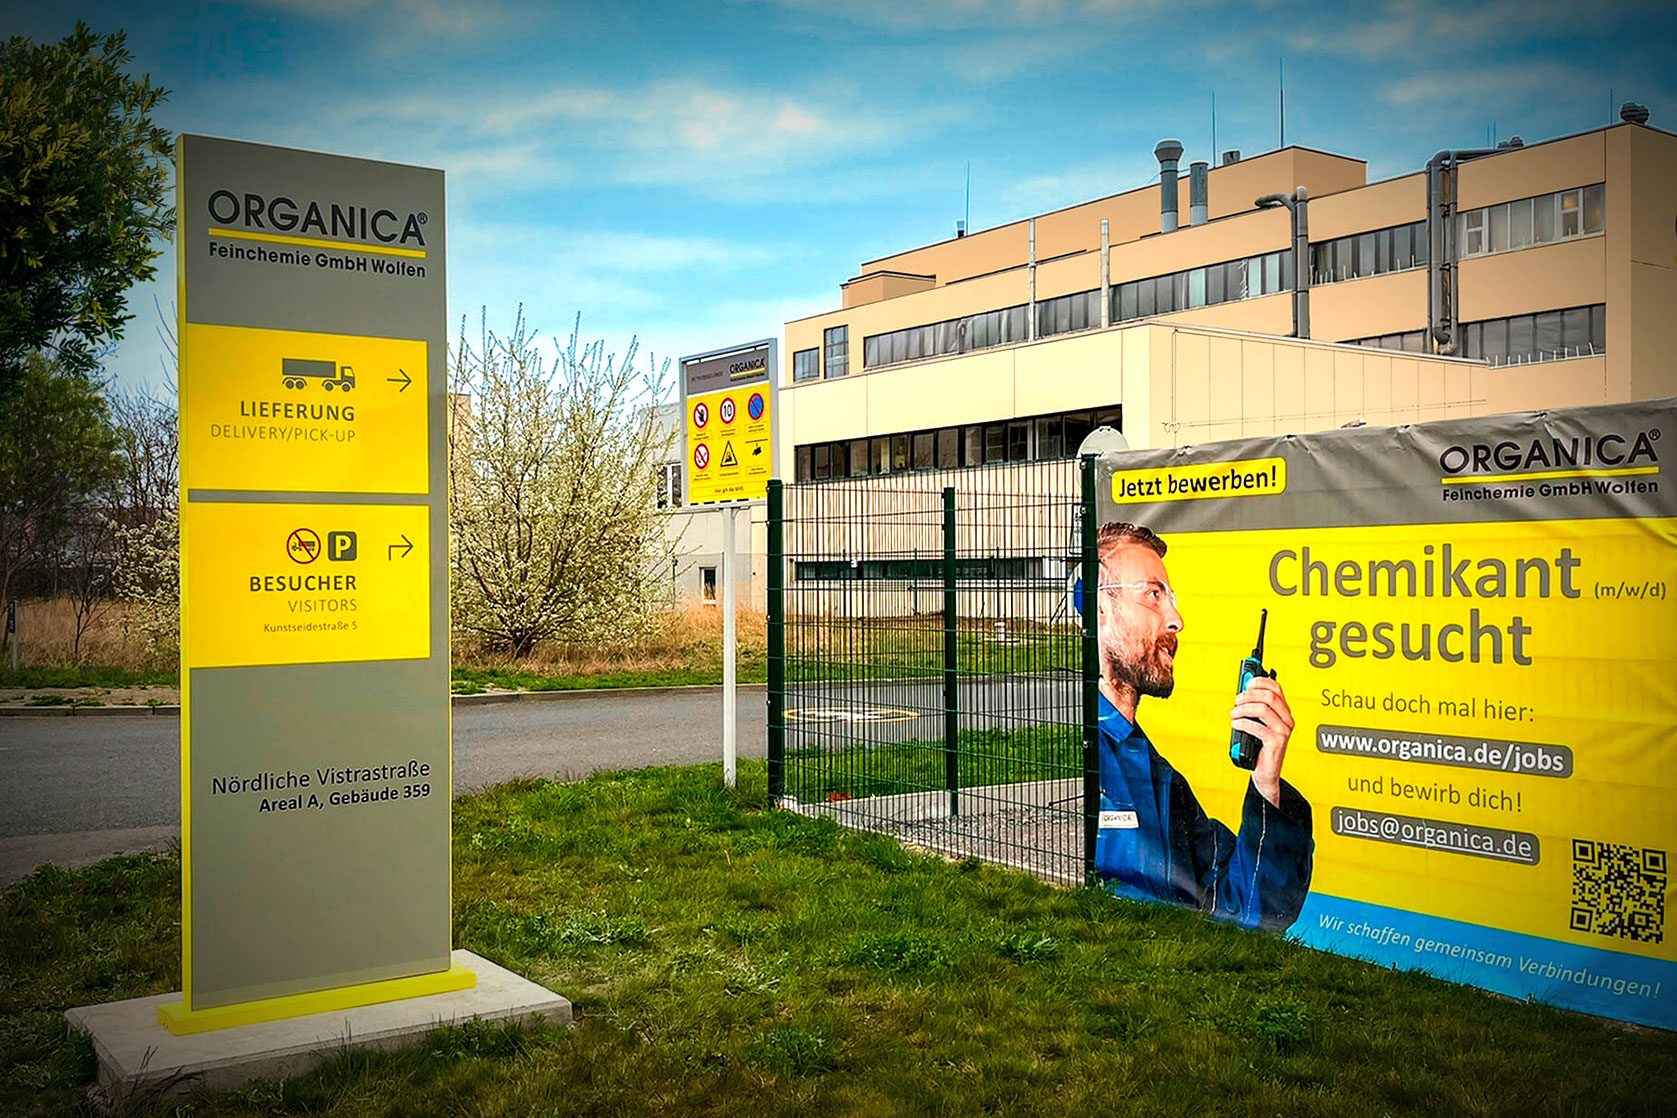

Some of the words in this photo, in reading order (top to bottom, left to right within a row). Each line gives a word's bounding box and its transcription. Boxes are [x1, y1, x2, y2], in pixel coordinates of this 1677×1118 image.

[209, 241, 311, 266] Feinchemie
[315, 253, 367, 273] GmbH
[371, 258, 426, 278] Wolfen
[240, 400, 355, 422] LIEFERUNG
[723, 404, 733, 418] 10
[211, 424, 356, 443] DELIVERY/PICK-UP
[1119, 476, 1162, 498] Jetzt
[1168, 465, 1277, 493] bewerben!
[1442, 485, 1535, 501] Feinchemie
[1539, 482, 1592, 497] GmbH
[1594, 480, 1659, 495] Wolfen
[250, 574, 357, 593] BESUCHER
[1268, 543, 1581, 599] Chemikant
[1594, 581, 1667, 601] (m/w/d)
[288, 598, 358, 614] VISITORS
[264, 621, 349, 634] Kunstseidestraße
[351, 620, 358, 631] 5
[1309, 608, 1532, 669] gesucht
[1320, 688, 1377, 711] Schau
[1382, 692, 1432, 715] doch
[1437, 697, 1477, 718] mal
[1484, 698, 1535, 723] hier:
[1321, 731, 1565, 774] www.organica.de/jobs
[212, 771, 311, 796] Nördliche
[316, 760, 431, 786] Vistrastraße
[1347, 775, 1385, 795] und
[1390, 780, 1461, 805] bewirb
[1468, 788, 1522, 814] dich!
[259, 793, 303, 812] Areal
[307, 794, 325, 811] A,
[329, 787, 399, 808] Gebäude
[403, 783, 431, 799] 359
[1336, 810, 1535, 862] jobs@organica.de
[1318, 913, 1344, 931] Wir
[1347, 922, 1411, 948] schaffen
[1414, 938, 1513, 968] gemeinsam
[1518, 957, 1662, 998] Verbindungen!
